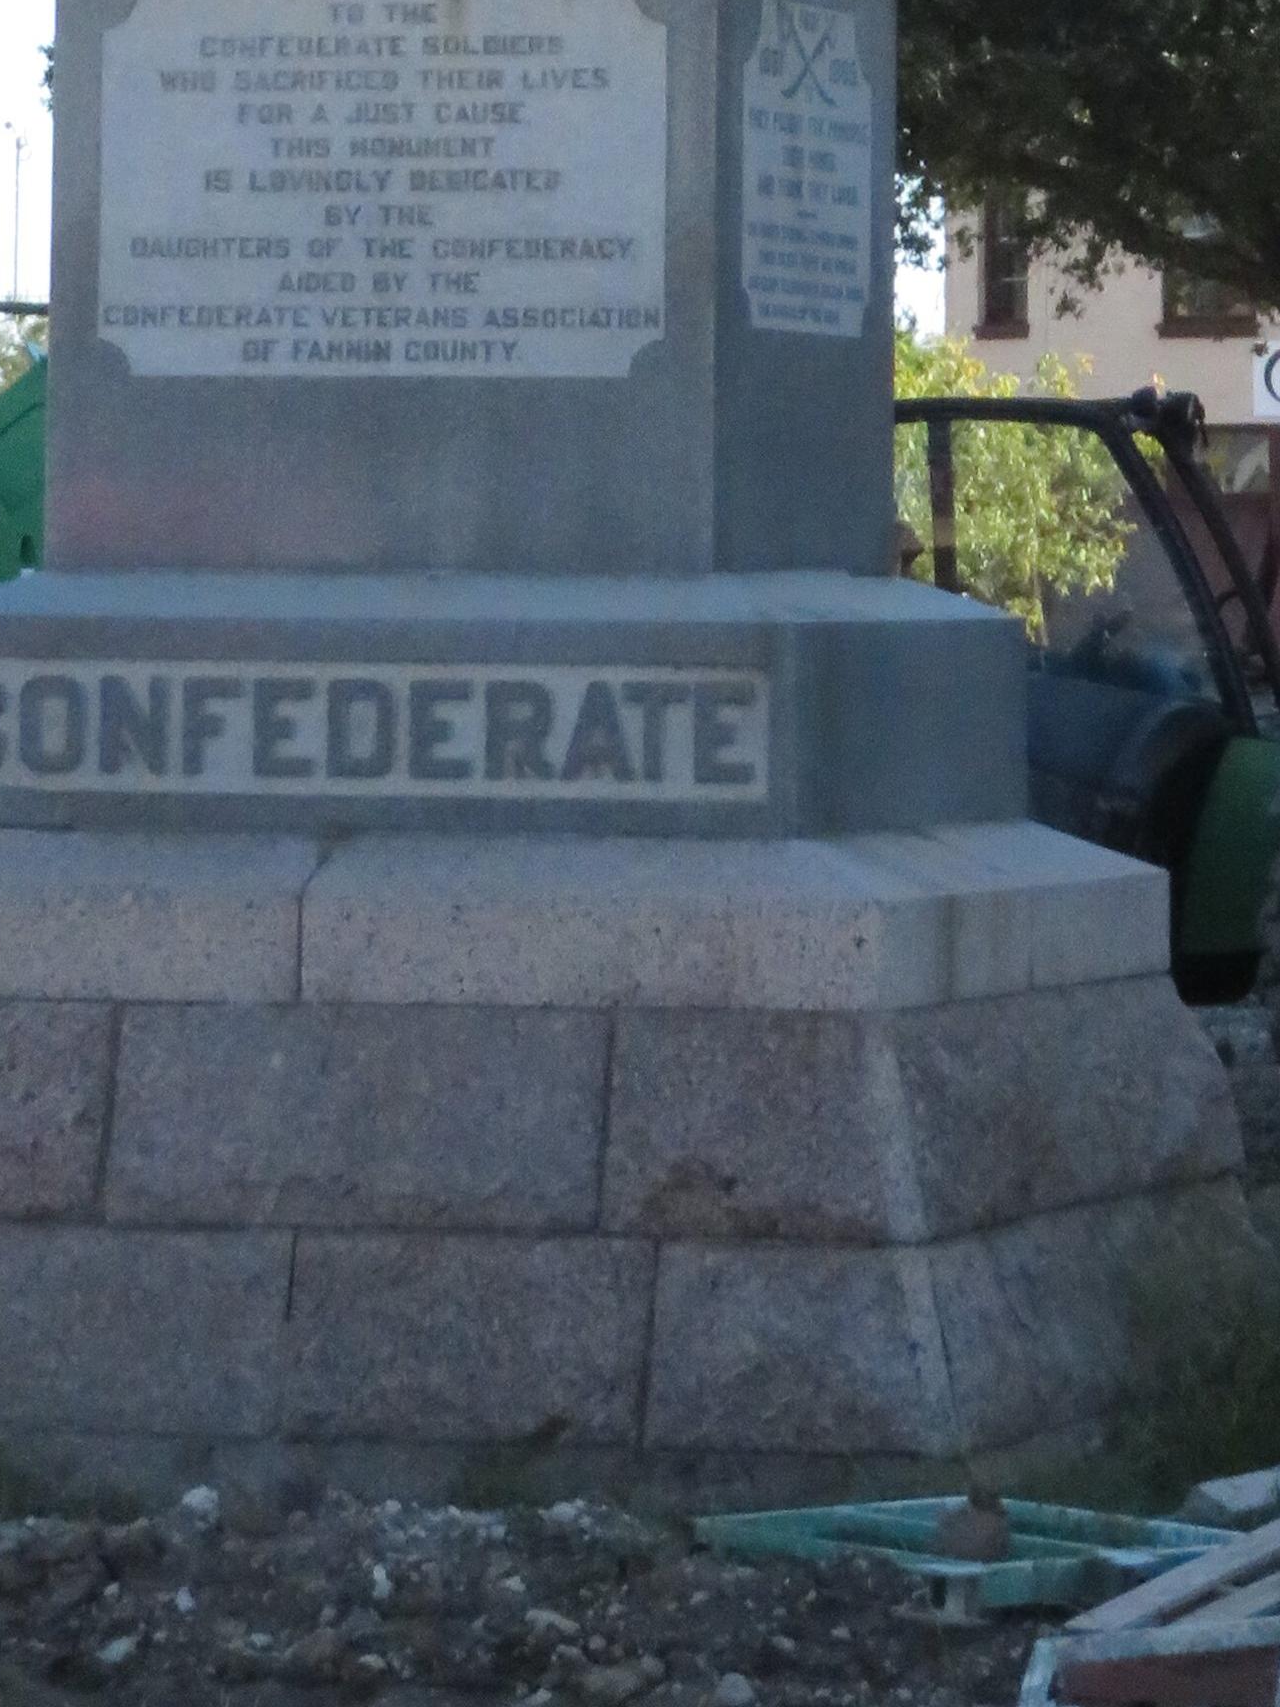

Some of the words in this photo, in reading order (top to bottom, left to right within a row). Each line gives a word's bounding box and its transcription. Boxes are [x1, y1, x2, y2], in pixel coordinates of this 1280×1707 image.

[382, 4, 437, 25] THE
[418, 69, 504, 92] THEIR
[522, 69, 611, 92] LIVES
[311, 102, 329, 125] A
[345, 102, 416, 125] JUST
[270, 137, 331, 158] THIS
[203, 170, 232, 192] IS
[379, 204, 434, 227] THE
[130, 237, 291, 259] DAUGHTERS
[363, 237, 414, 259] THE
[428, 272, 481, 293] THE
[102, 305, 309, 328] CONFEDERATE
[320, 305, 469, 328] VETERANS
[483, 305, 661, 328] ASSOCIATION
